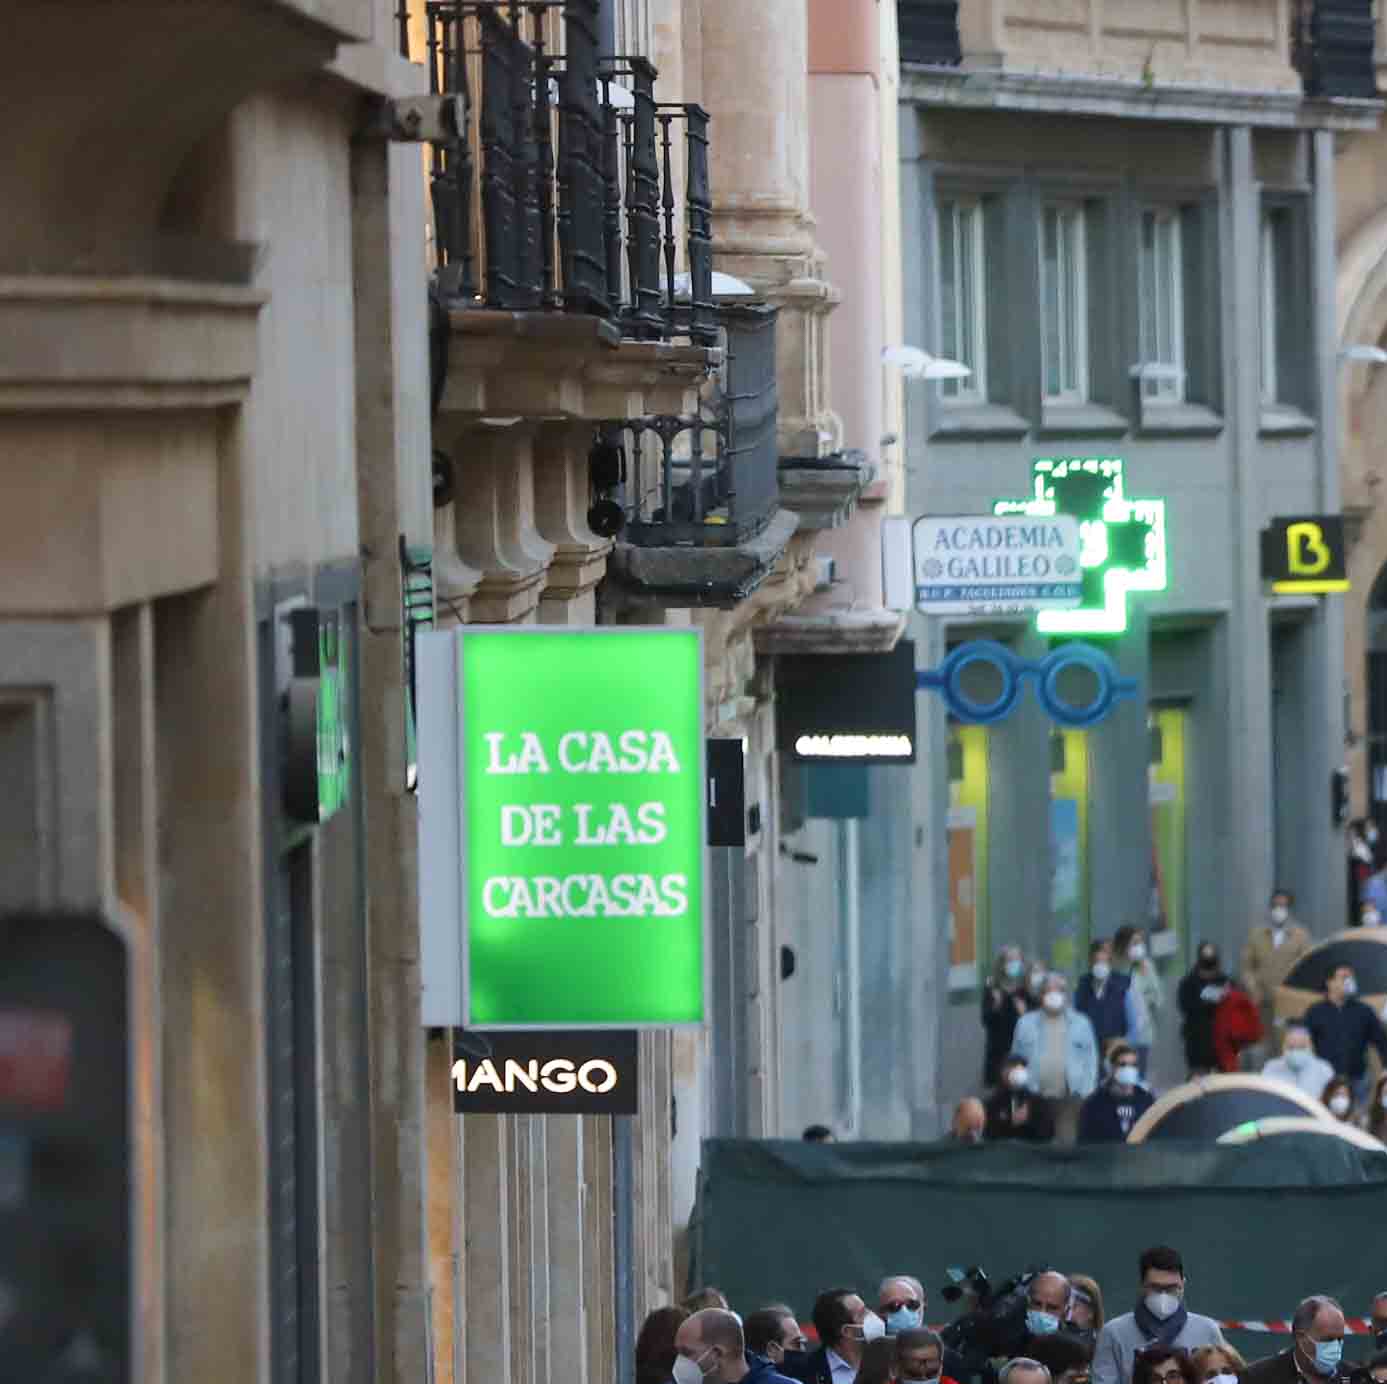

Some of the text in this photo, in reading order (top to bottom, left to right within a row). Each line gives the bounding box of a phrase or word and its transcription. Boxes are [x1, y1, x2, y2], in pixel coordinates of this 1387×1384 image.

[935, 525, 1064, 550] ACADEMIA
[947, 554, 1050, 578] GALILEO
[483, 729, 681, 774] LA CASA
[501, 801, 668, 846] DE LAS
[482, 873, 689, 919] CARCASAS
